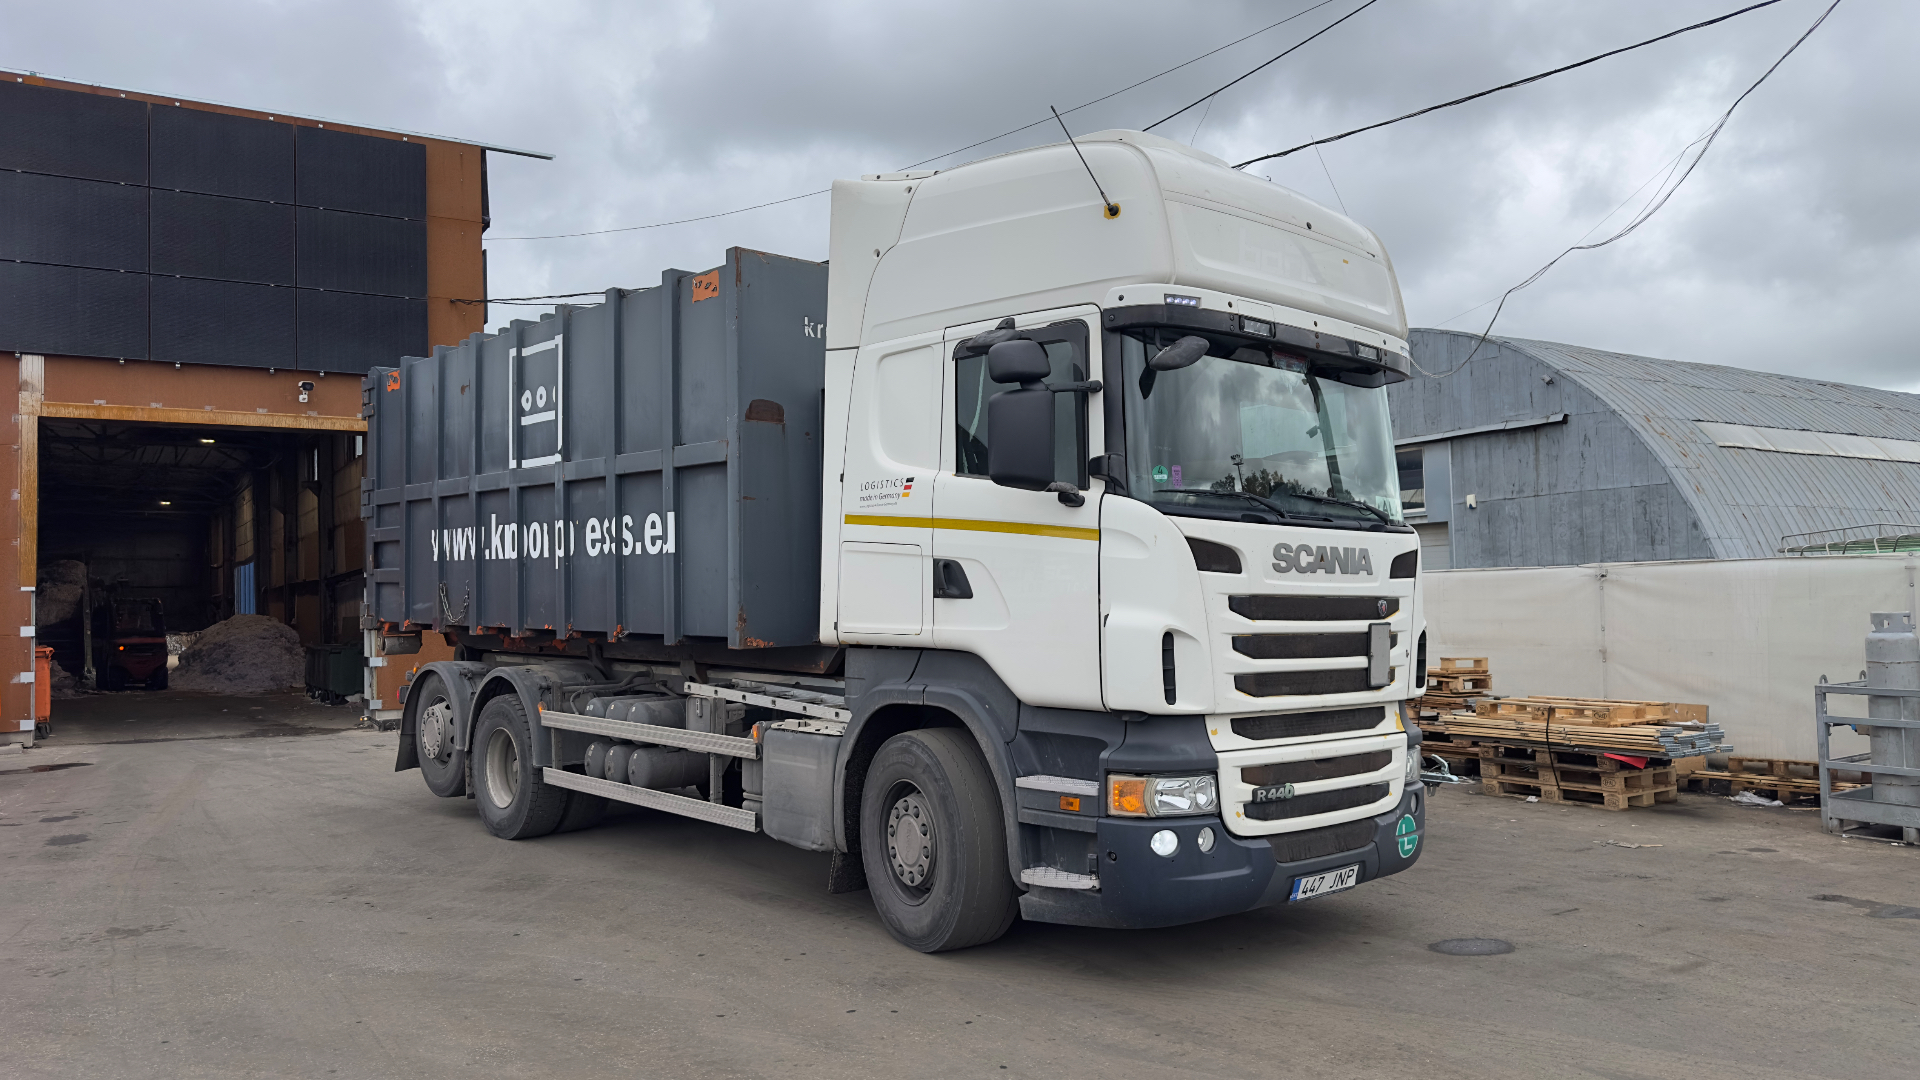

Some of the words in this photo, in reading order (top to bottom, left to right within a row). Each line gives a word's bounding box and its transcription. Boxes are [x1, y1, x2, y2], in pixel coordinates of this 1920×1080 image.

[804, 316, 827, 338] kr
[860, 477, 904, 491] LOGISTICS
[879, 492, 901, 501] Germany
[1272, 542, 1373, 575] SCANIA
[1257, 789, 1267, 802] R
[1267, 785, 1294, 800] 440
[1302, 876, 1325, 896] 447
[1329, 869, 1355, 889] JNP
